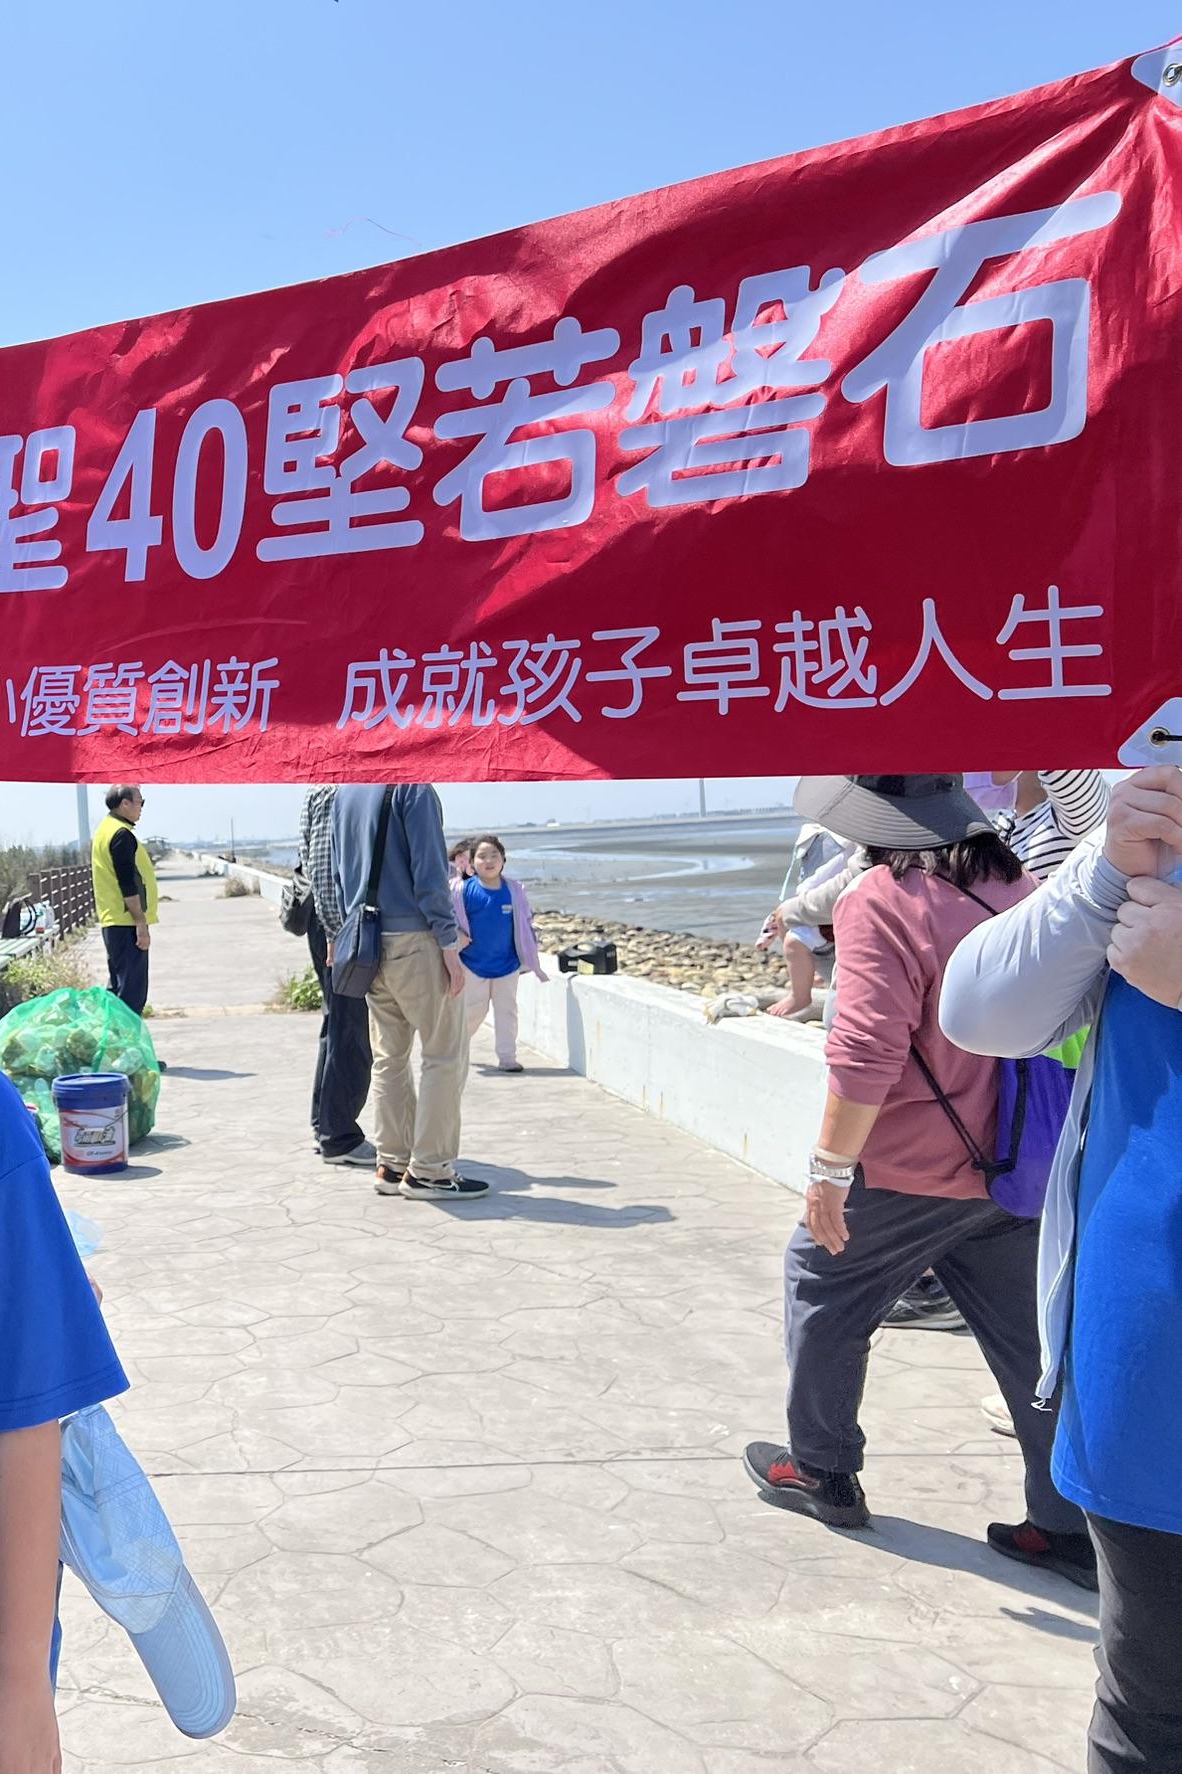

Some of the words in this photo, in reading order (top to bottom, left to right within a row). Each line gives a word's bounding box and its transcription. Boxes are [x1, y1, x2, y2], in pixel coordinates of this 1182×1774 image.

[335, 584, 1113, 731] 成就孩子卓越人生
